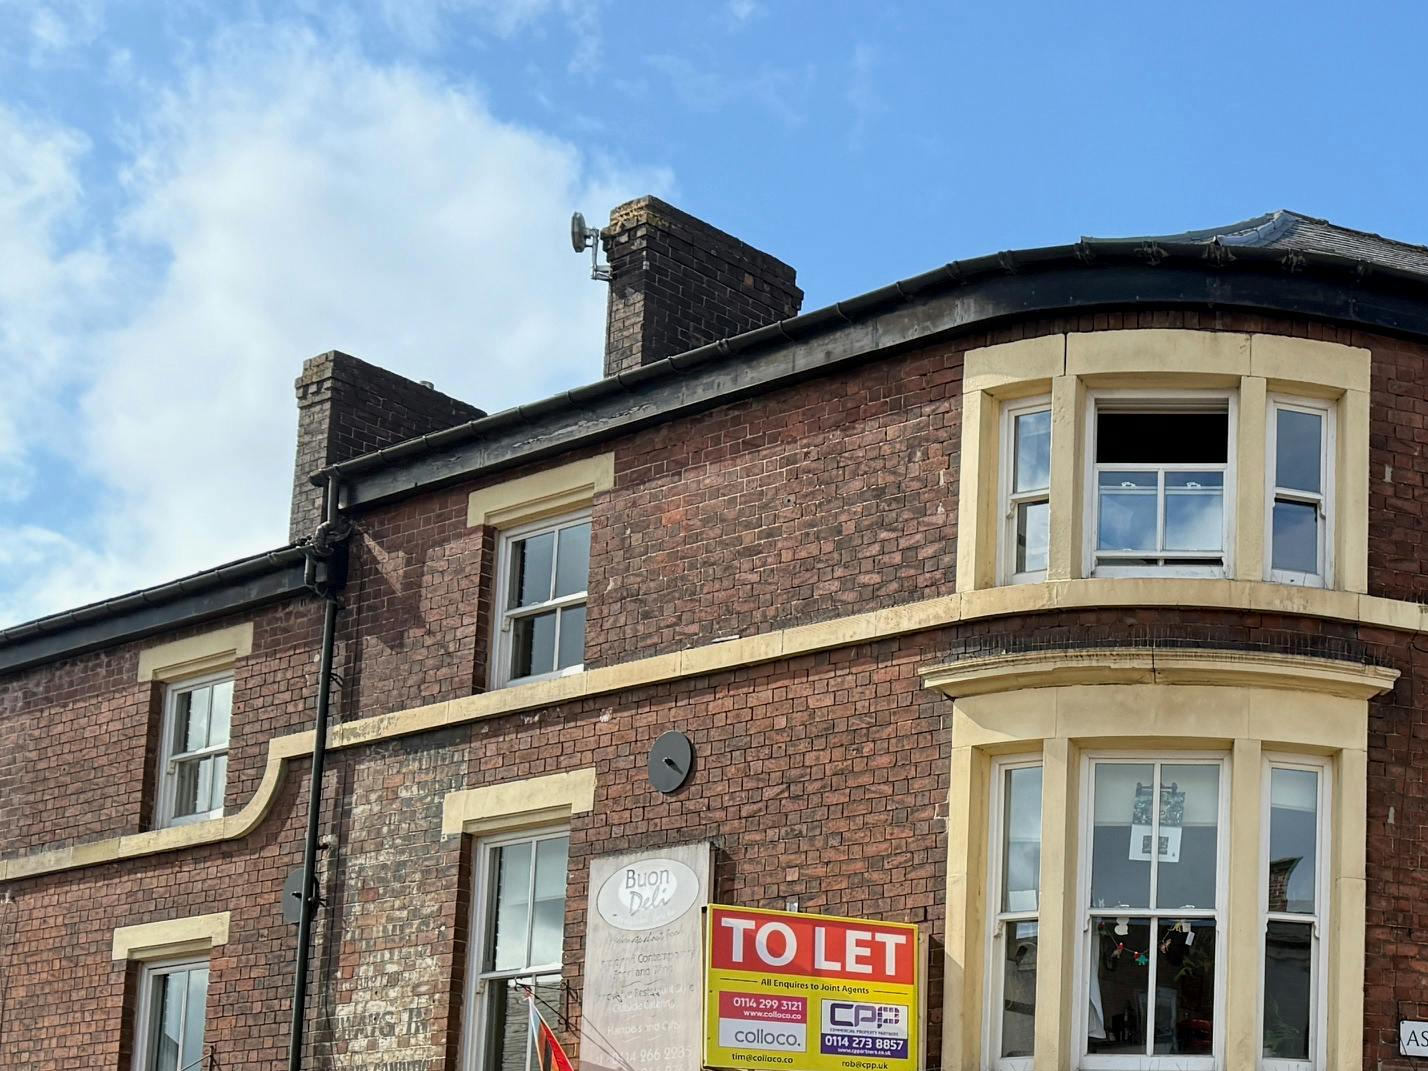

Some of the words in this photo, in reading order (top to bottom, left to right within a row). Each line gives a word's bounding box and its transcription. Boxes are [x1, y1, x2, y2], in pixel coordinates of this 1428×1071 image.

[624, 868, 670, 889] Buon
[630, 884, 672, 917] Deli
[721, 917, 798, 967] TO
[814, 926, 907, 976] LET
[760, 978, 772, 986] All
[773, 980, 809, 990] Enquires
[820, 984, 840, 992] Joint
[841, 985, 870, 995] Agents
[733, 997, 757, 1007] 0114
[759, 999, 779, 1009] 299
[780, 1001, 802, 1011] 3121
[743, 1010, 802, 1020] www.colloco.co
[825, 1035, 849, 1047] 0114
[852, 1037, 872, 1049] 273
[875, 1039, 904, 1050] 8857
[732, 1053, 794, 1063] tim@colloco.co
[841, 1060, 889, 1070] rob@cpp.uk
